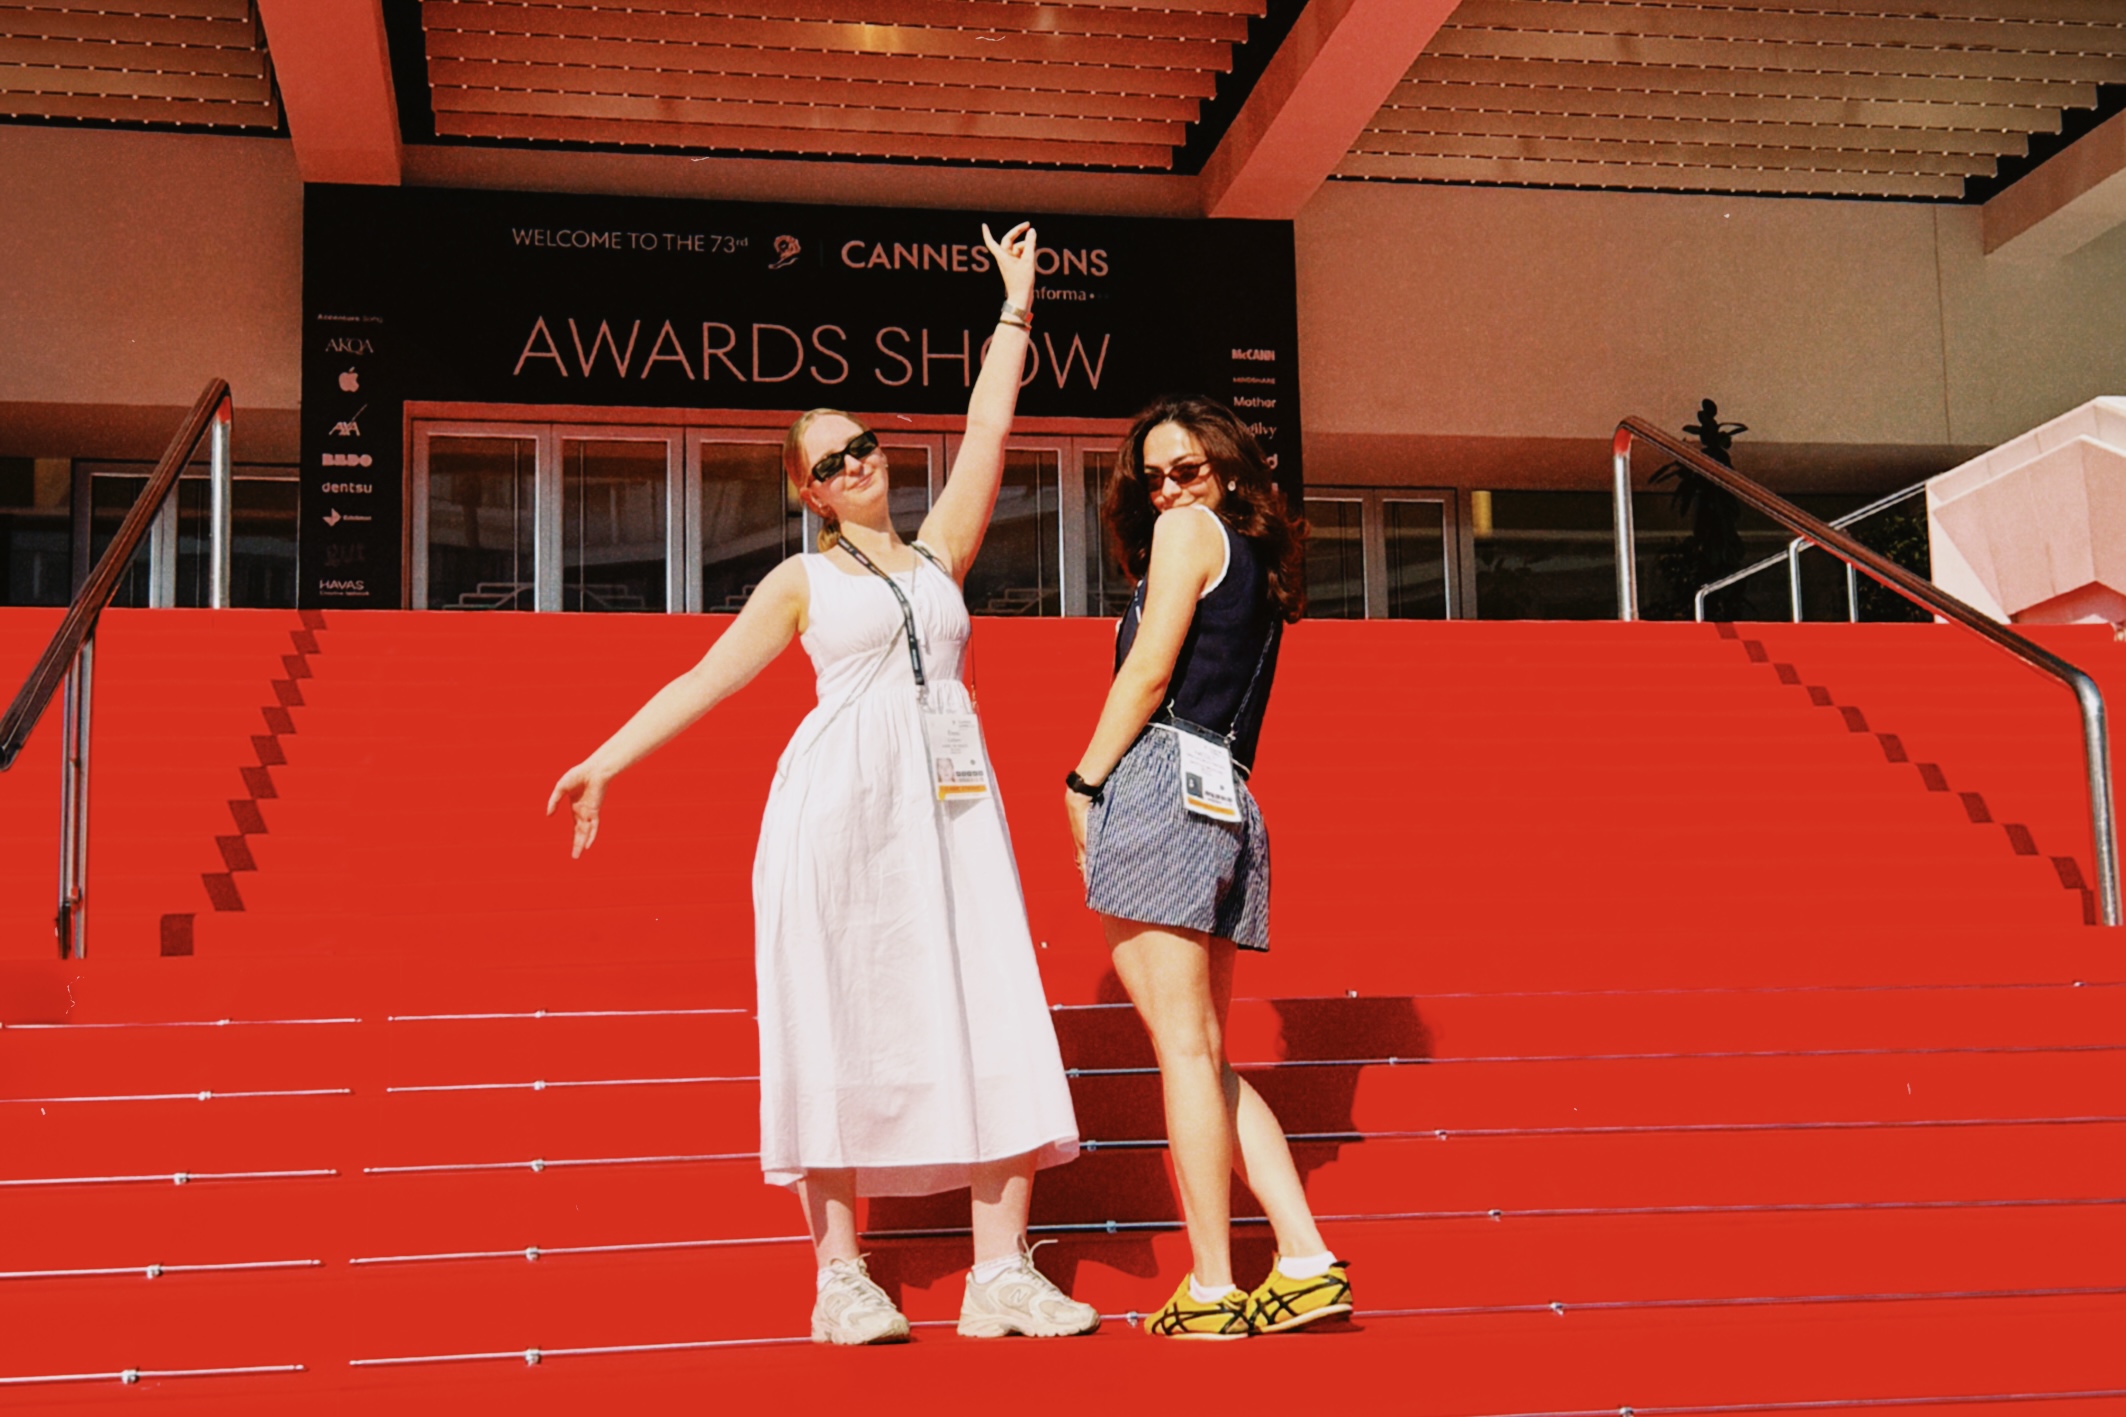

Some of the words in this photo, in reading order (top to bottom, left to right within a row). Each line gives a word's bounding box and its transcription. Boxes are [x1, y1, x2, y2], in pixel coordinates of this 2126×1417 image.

[512, 228, 622, 249] WELCOME
[627, 232, 658, 250] TO
[662, 233, 704, 251] THE
[710, 235, 748, 253] 73rd
[841, 240, 991, 272] CANNES
[1034, 247, 1109, 277] ONS
[1033, 286, 1087, 301] nforma
[325, 338, 374, 355] AKQA
[513, 316, 848, 384] AWARDS
[1231, 348, 1275, 361] McCANN
[1233, 396, 1277, 408] Mother
[322, 453, 373, 467] BBDO
[322, 482, 373, 494] dentsu
[319, 579, 365, 590] HAVAS
